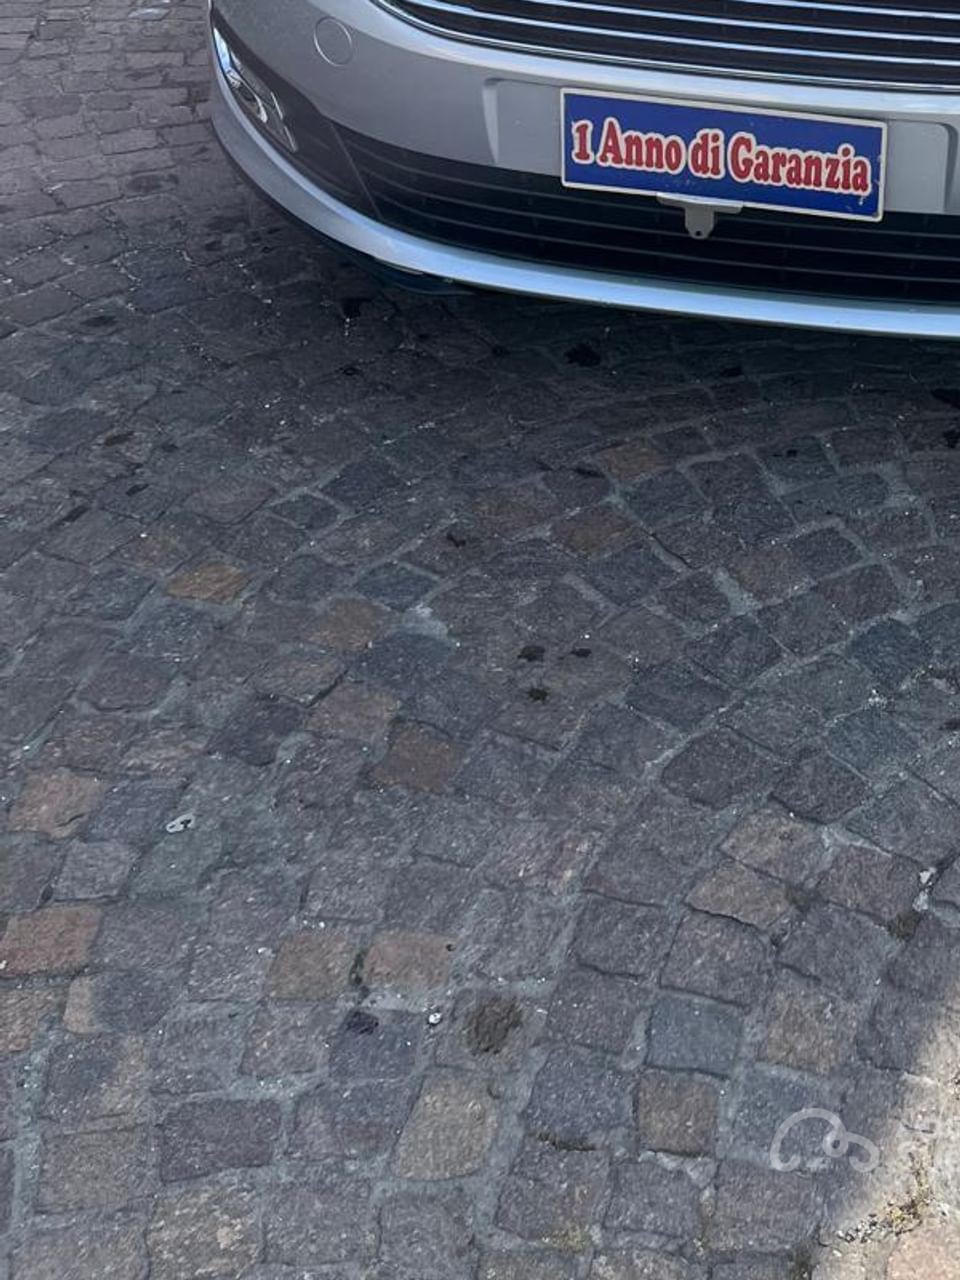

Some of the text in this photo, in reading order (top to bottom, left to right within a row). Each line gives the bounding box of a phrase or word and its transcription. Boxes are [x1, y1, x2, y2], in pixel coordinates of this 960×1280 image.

[572, 117, 871, 195] 1 Anno di Garanzia
